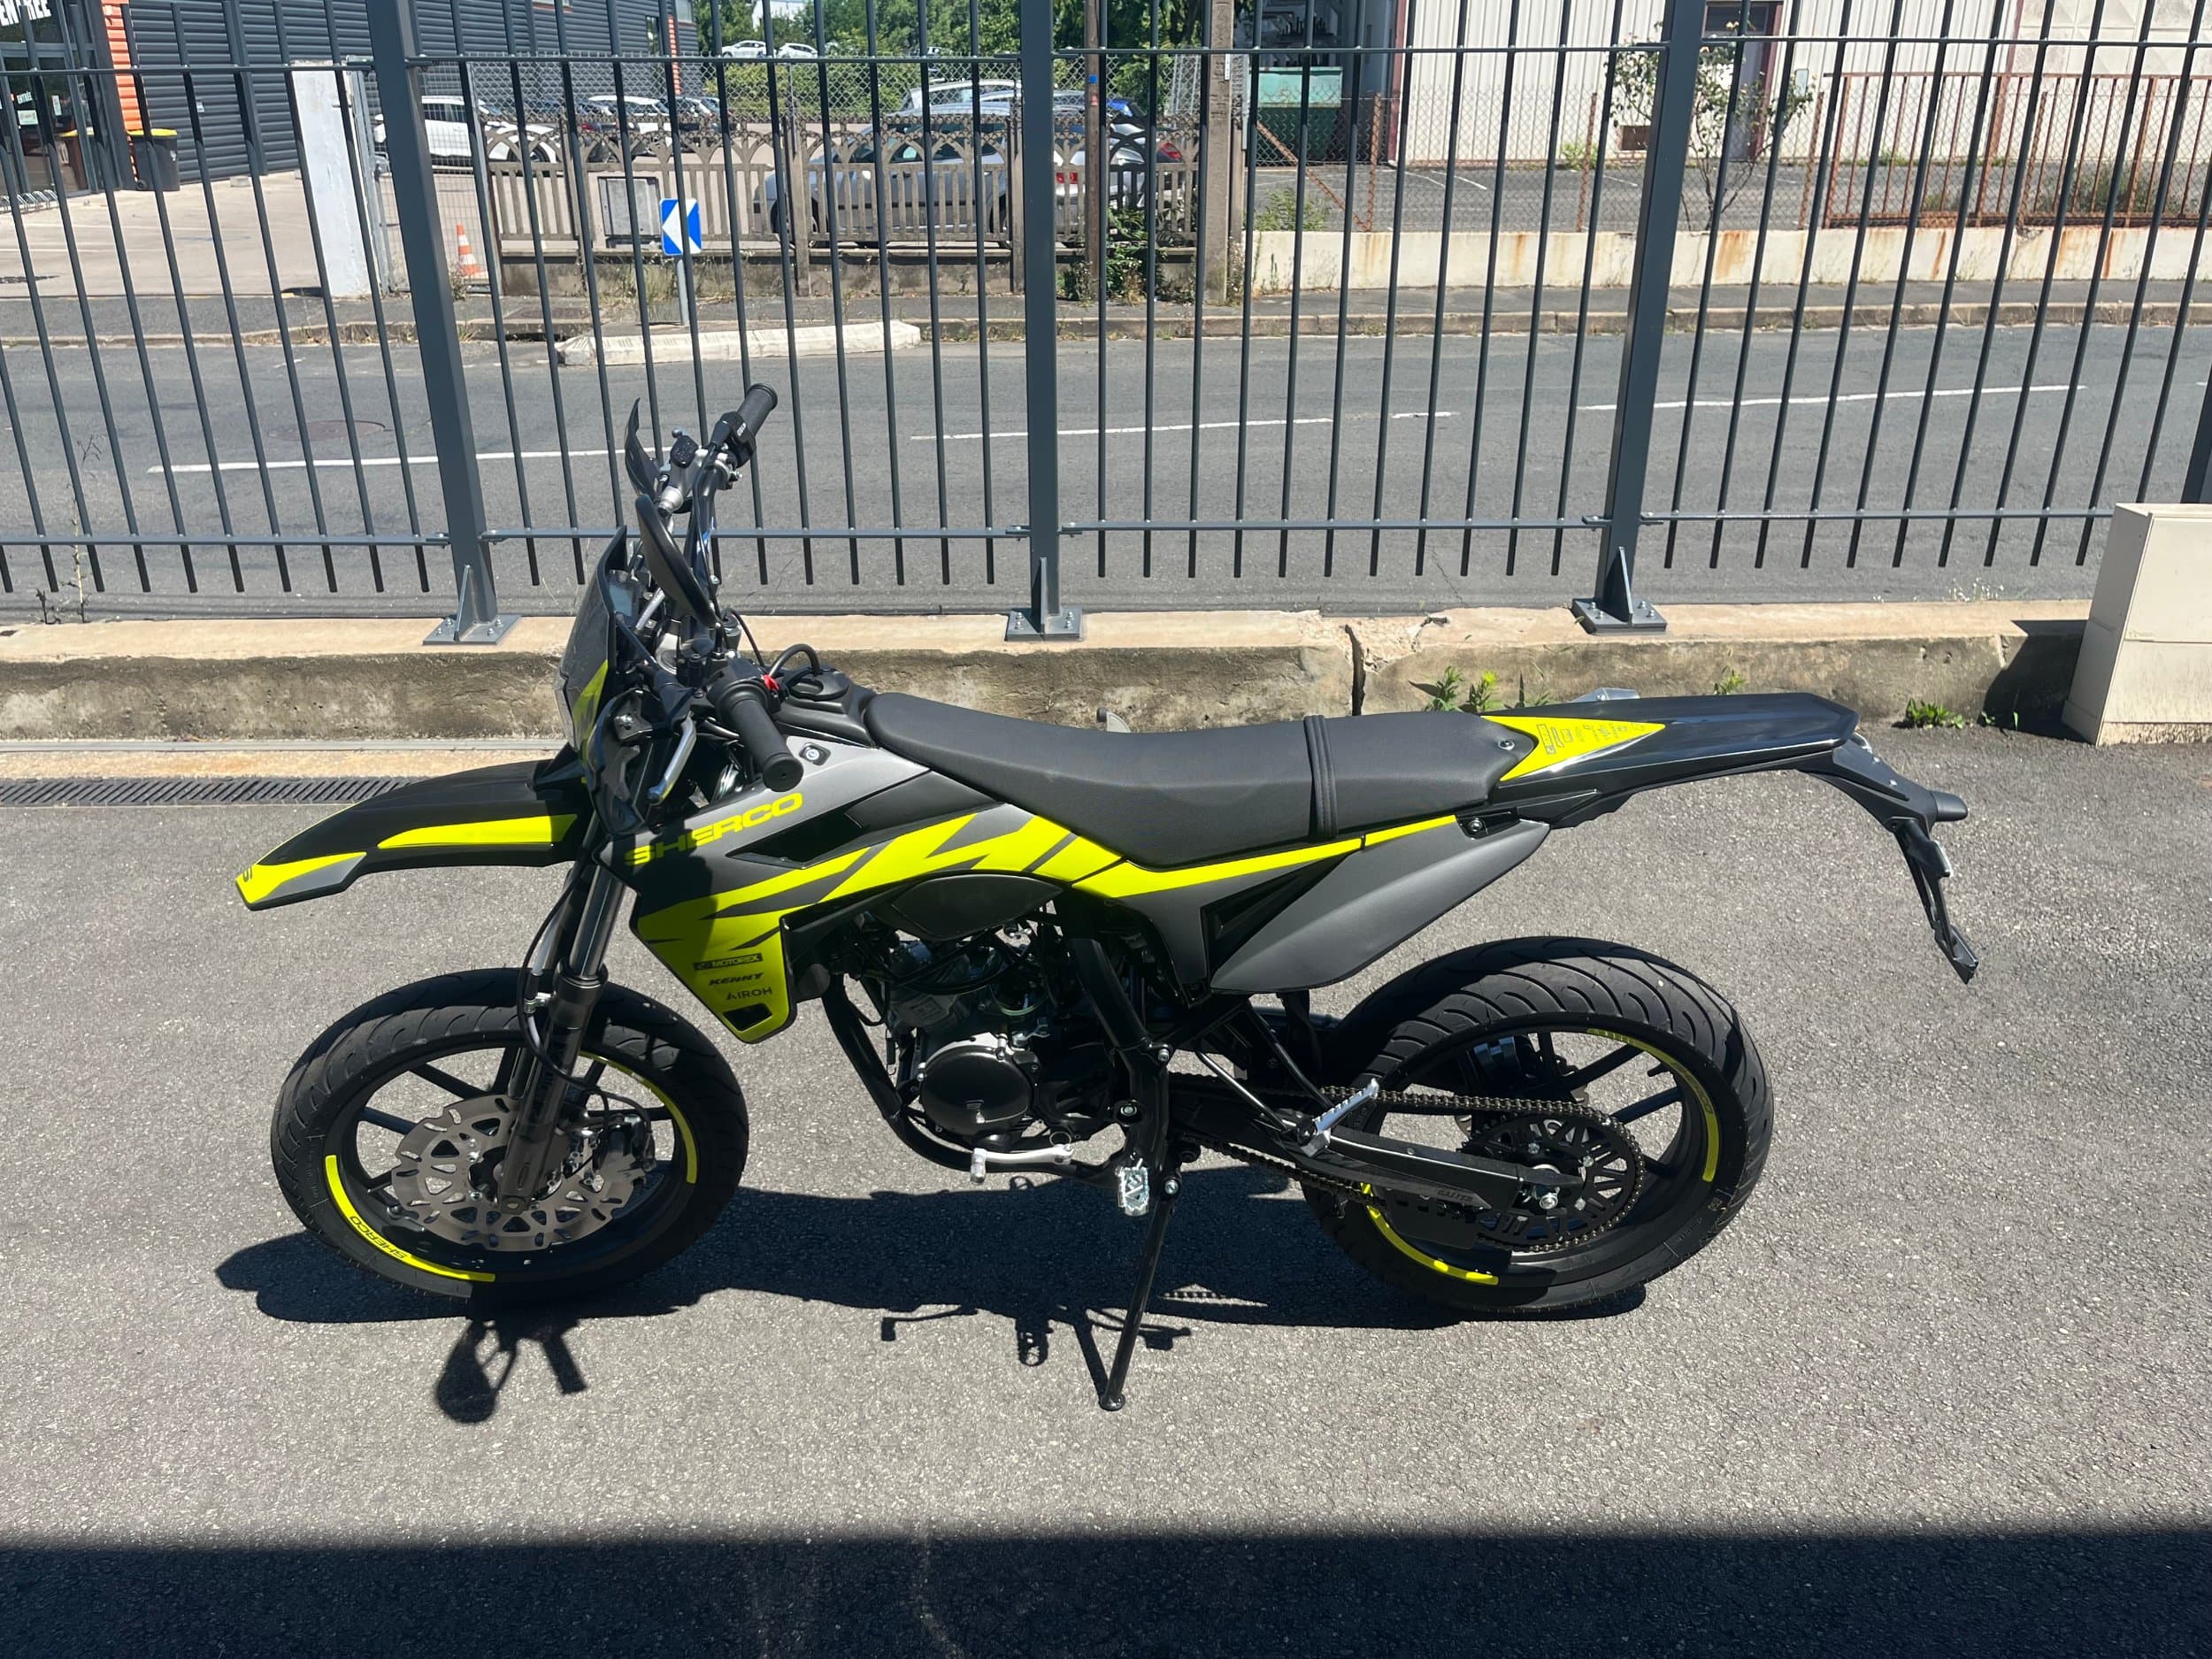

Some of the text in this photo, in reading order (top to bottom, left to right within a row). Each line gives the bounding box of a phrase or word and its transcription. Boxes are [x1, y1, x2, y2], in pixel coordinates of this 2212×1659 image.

[625, 792, 803, 865] SHERCO
[711, 955, 759, 968] MOTOREX
[709, 972, 764, 986] KENNY
[726, 987, 772, 1000] AIROH
[349, 1216, 408, 1258] SHERCO
